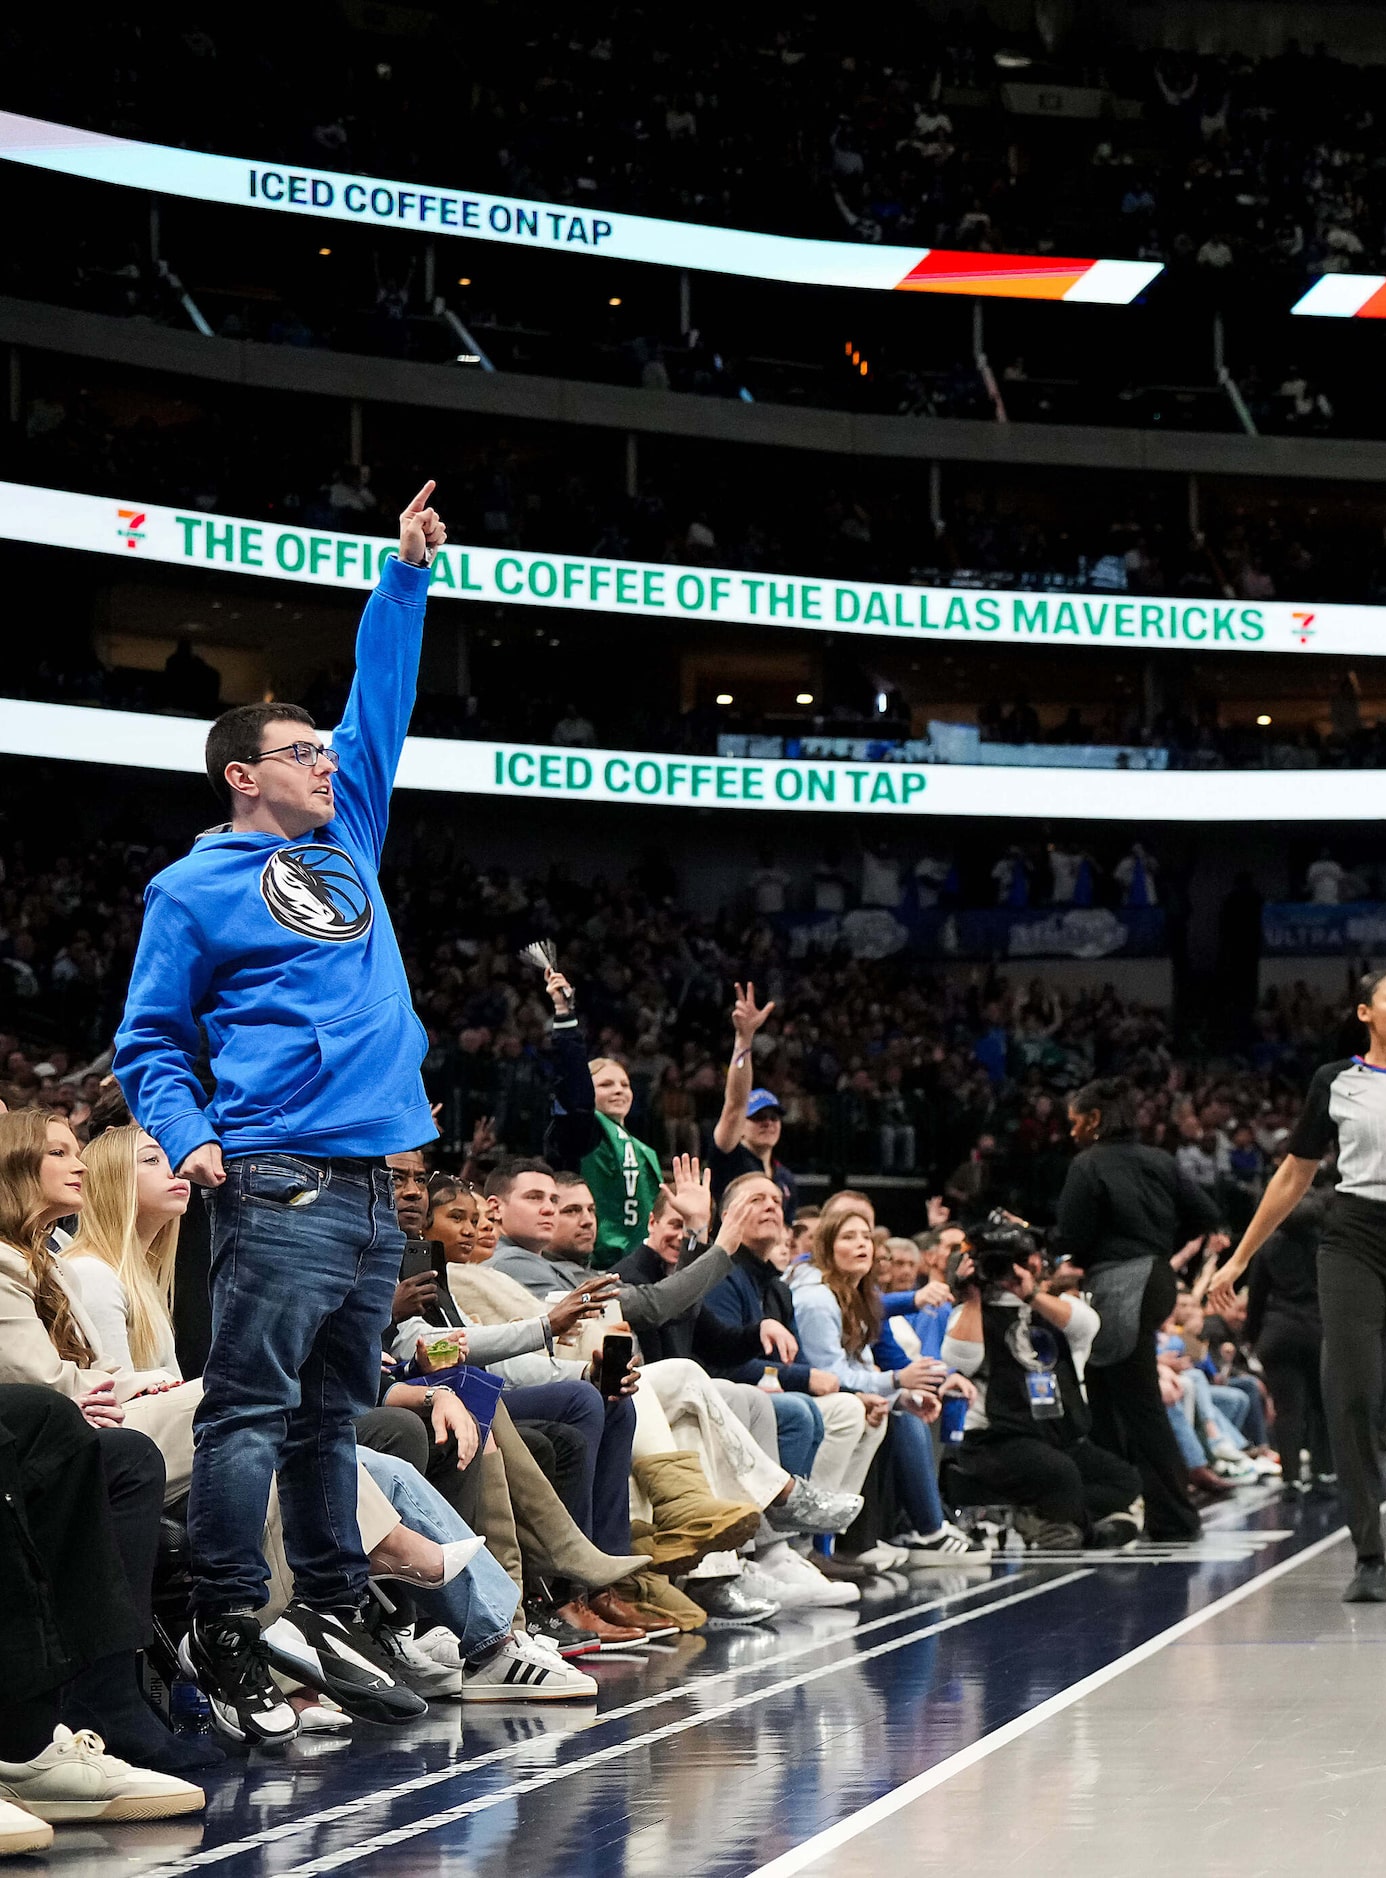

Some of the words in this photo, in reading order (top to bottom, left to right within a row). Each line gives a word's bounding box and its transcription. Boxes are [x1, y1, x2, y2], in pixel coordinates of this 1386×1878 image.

[249, 169, 334, 208] ICED
[343, 183, 481, 229] COFFEE
[489, 204, 538, 237] ON
[546, 211, 613, 246] TAP
[175, 515, 264, 567] THE
[275, 532, 483, 591] OFFIAL
[494, 557, 666, 608] COFFEE
[676, 573, 731, 612] OF
[741, 579, 822, 621] THE
[835, 587, 1001, 631] DALLAS
[1013, 599, 1265, 641] MAVERICKS
[494, 750, 593, 790] ICED
[603, 758, 764, 800] COFFEE
[775, 767, 836, 801] ON
[845, 769, 927, 805] TAP
